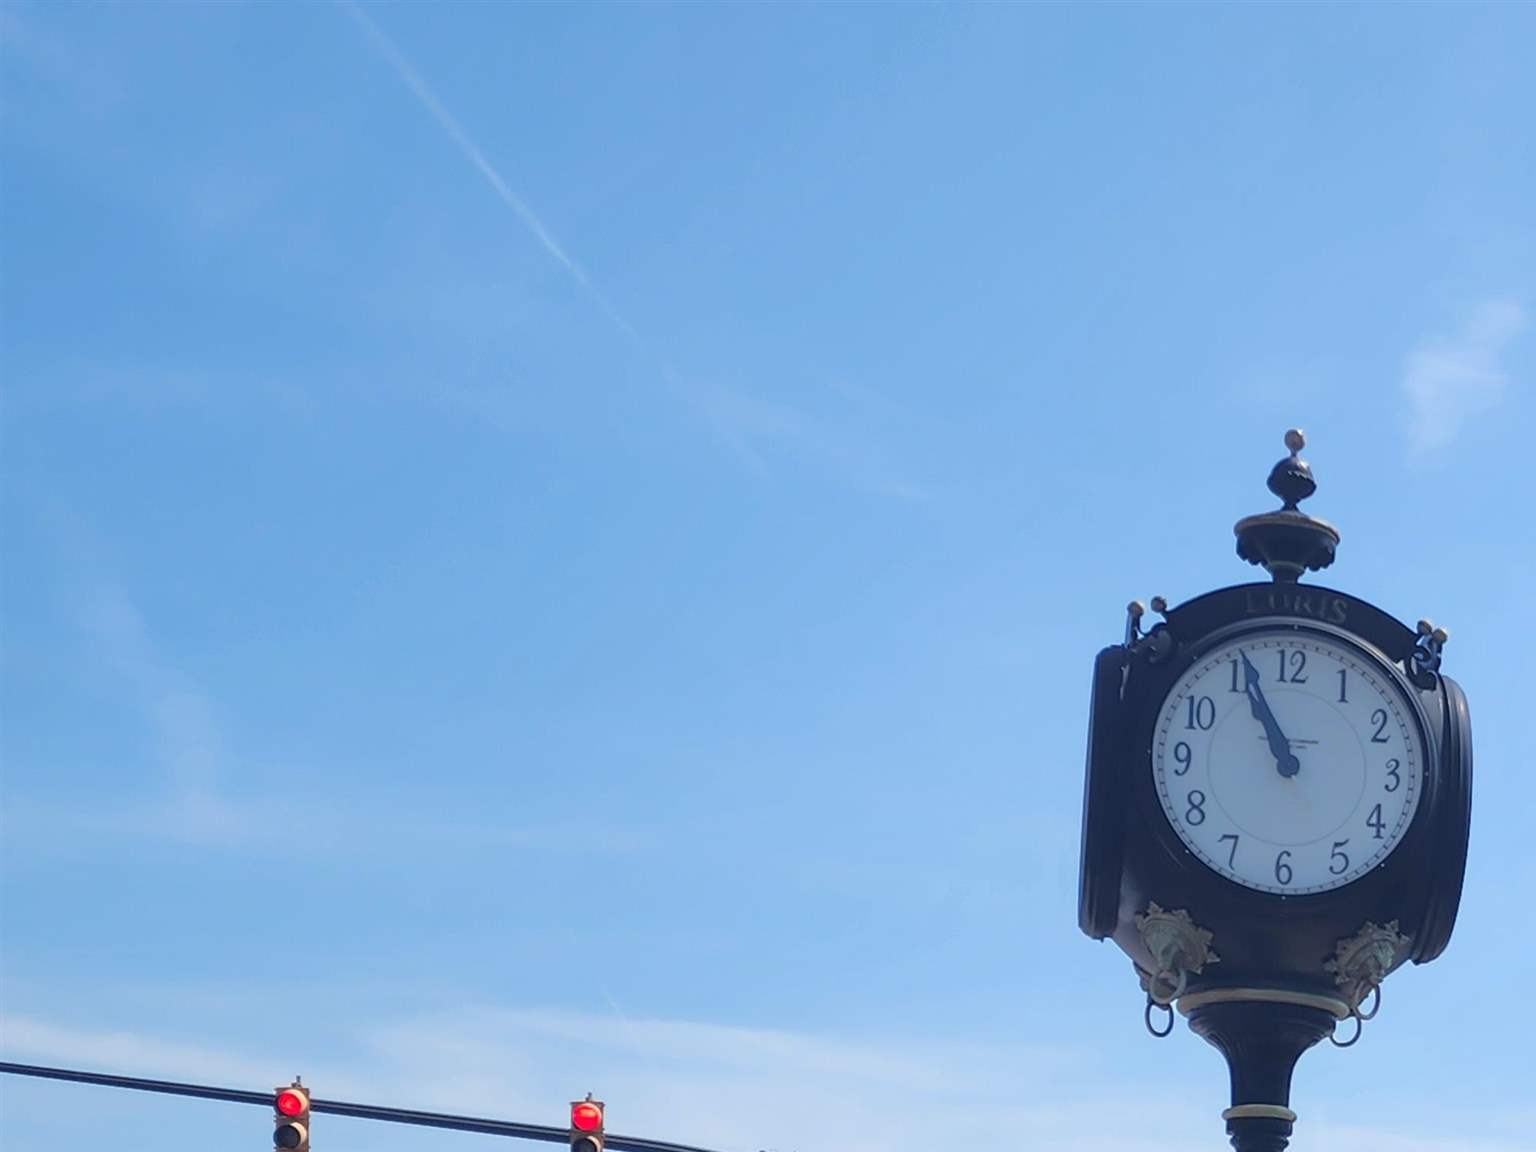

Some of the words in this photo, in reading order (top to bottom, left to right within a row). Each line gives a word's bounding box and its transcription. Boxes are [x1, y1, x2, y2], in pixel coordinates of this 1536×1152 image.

[1276, 650, 1307, 684] 12
[1336, 668, 1349, 703] 1
[1185, 696, 1216, 730] 10
[1370, 708, 1391, 743] 2
[1174, 742, 1192, 776] 9
[1384, 759, 1401, 792] 3
[1185, 790, 1206, 826] 8
[1366, 803, 1387, 839] 4
[1217, 834, 1240, 870] 7
[1275, 851, 1293, 885] 6
[1329, 838, 1350, 874] 5
